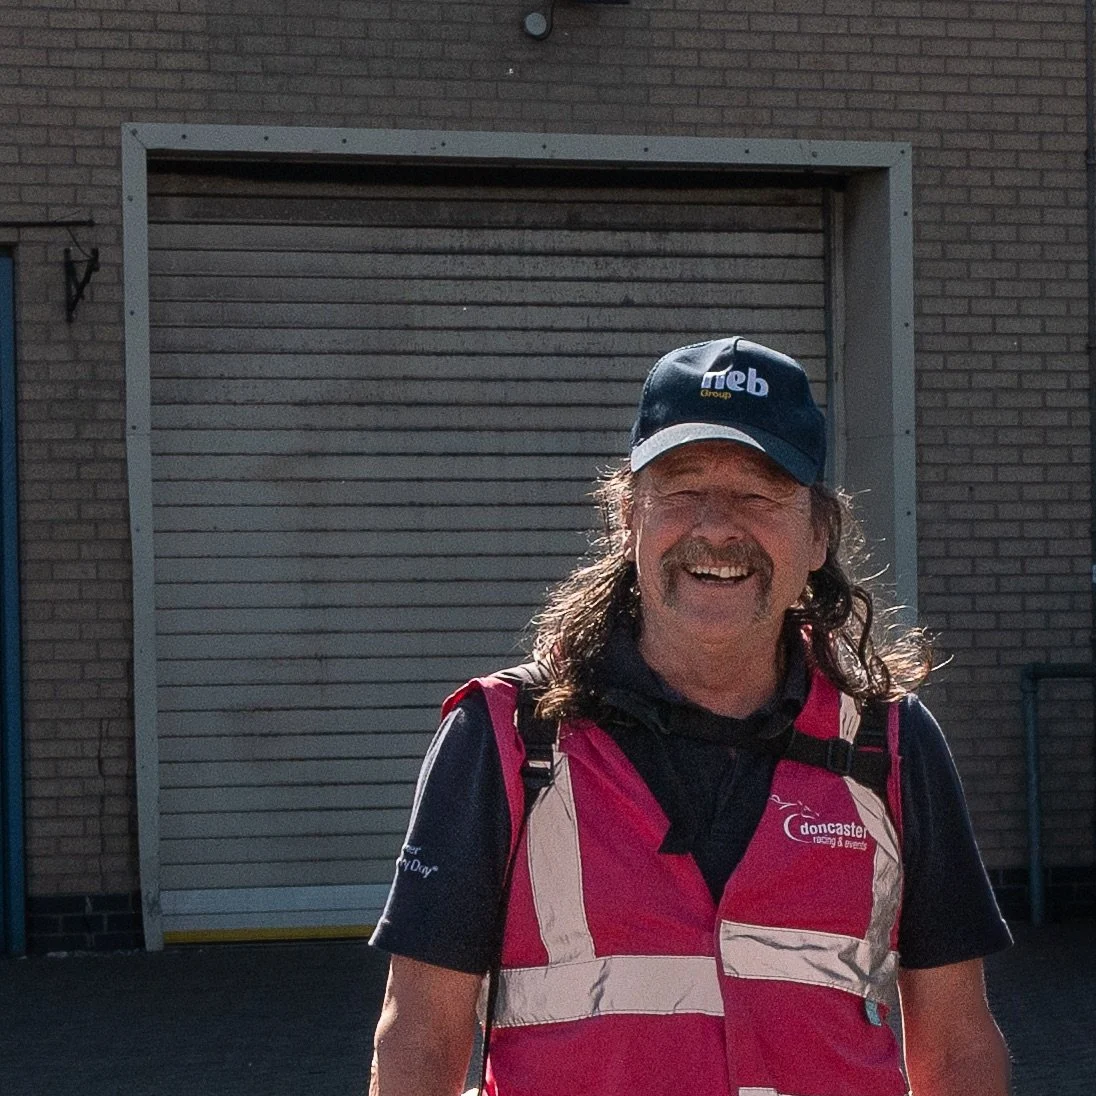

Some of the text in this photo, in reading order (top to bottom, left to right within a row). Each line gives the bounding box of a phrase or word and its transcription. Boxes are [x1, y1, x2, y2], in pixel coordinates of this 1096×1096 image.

[700, 389, 732, 400] Group
[800, 822, 867, 839] doncaster
[813, 836, 868, 851] racing & events
